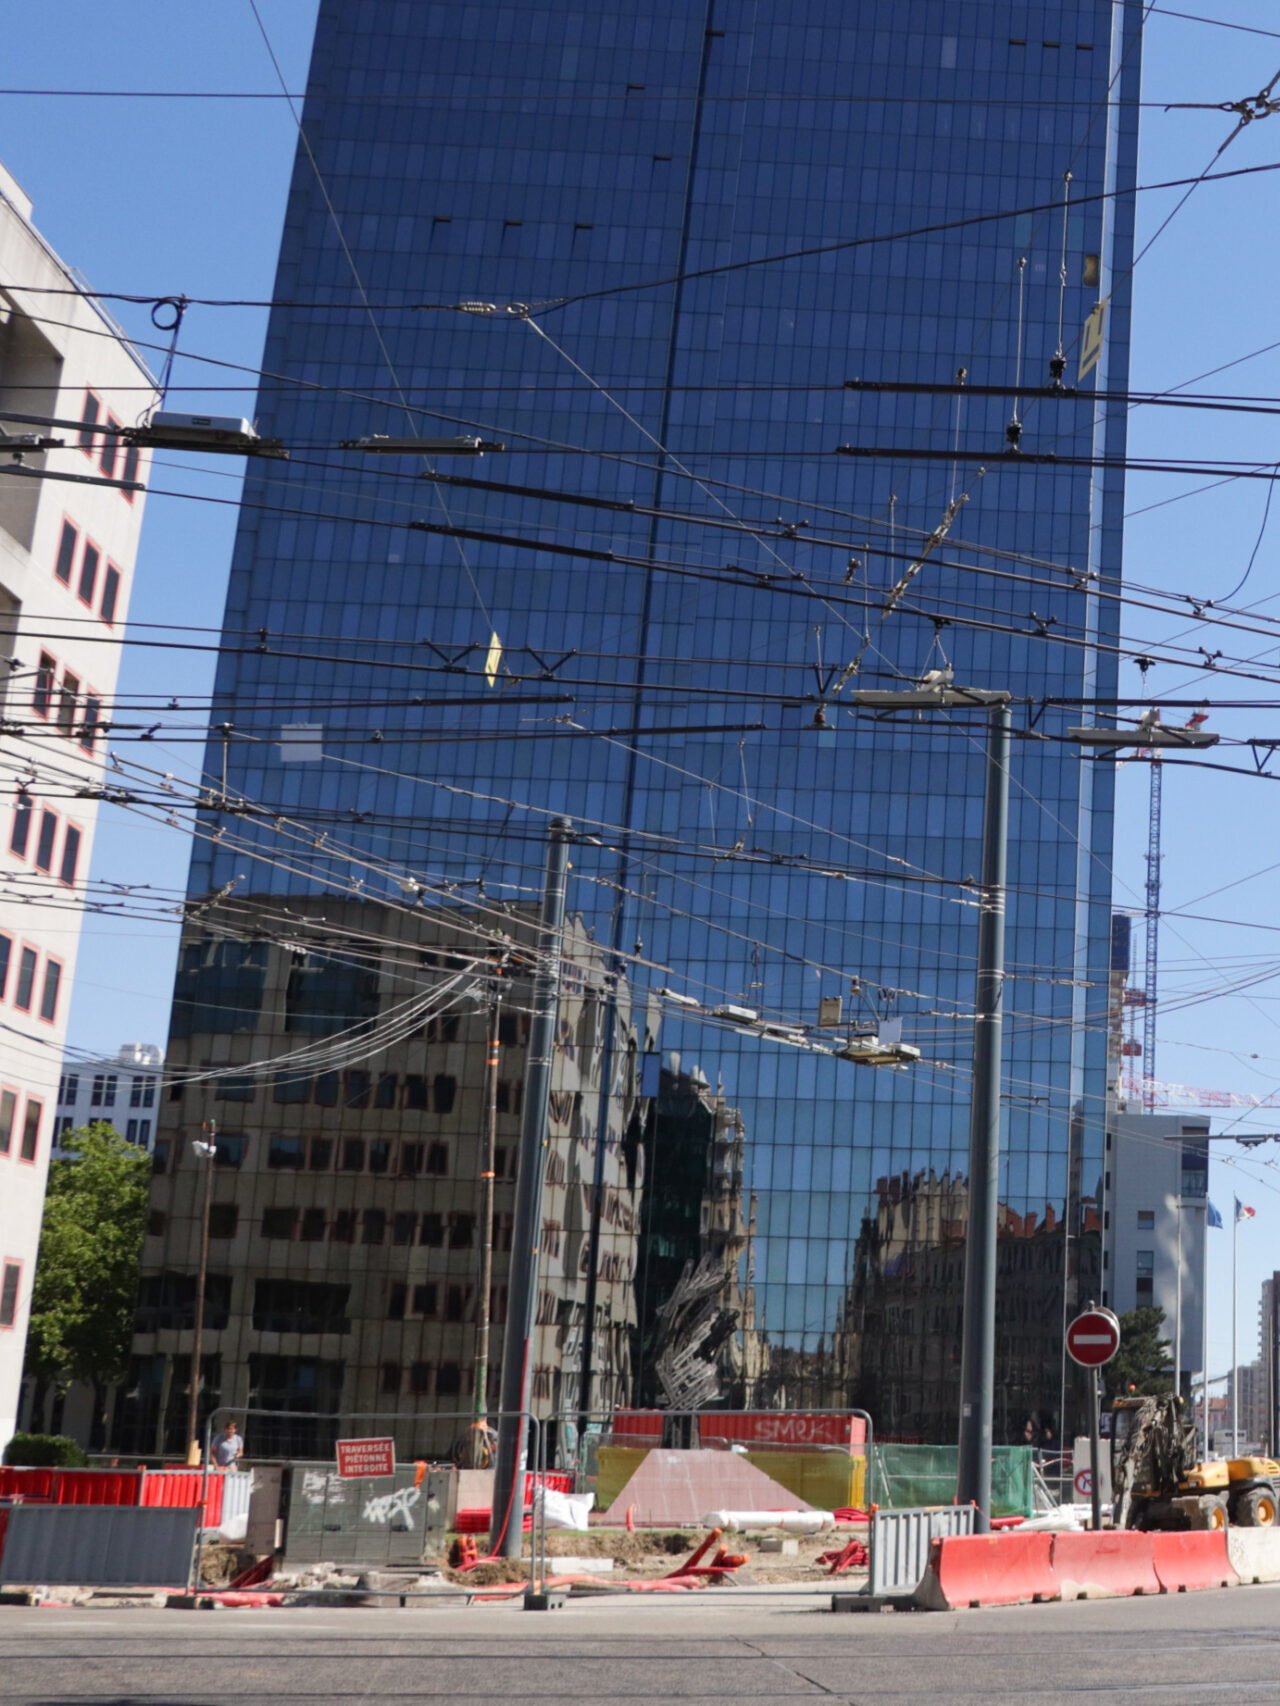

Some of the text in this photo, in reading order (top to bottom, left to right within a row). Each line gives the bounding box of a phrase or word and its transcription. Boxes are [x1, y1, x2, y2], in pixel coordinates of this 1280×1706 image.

[341, 1443, 390, 1453] TRAVERSÉE
[344, 1453, 387, 1463] PIÉTONNE
[344, 1463, 388, 1473] INTERDITE
